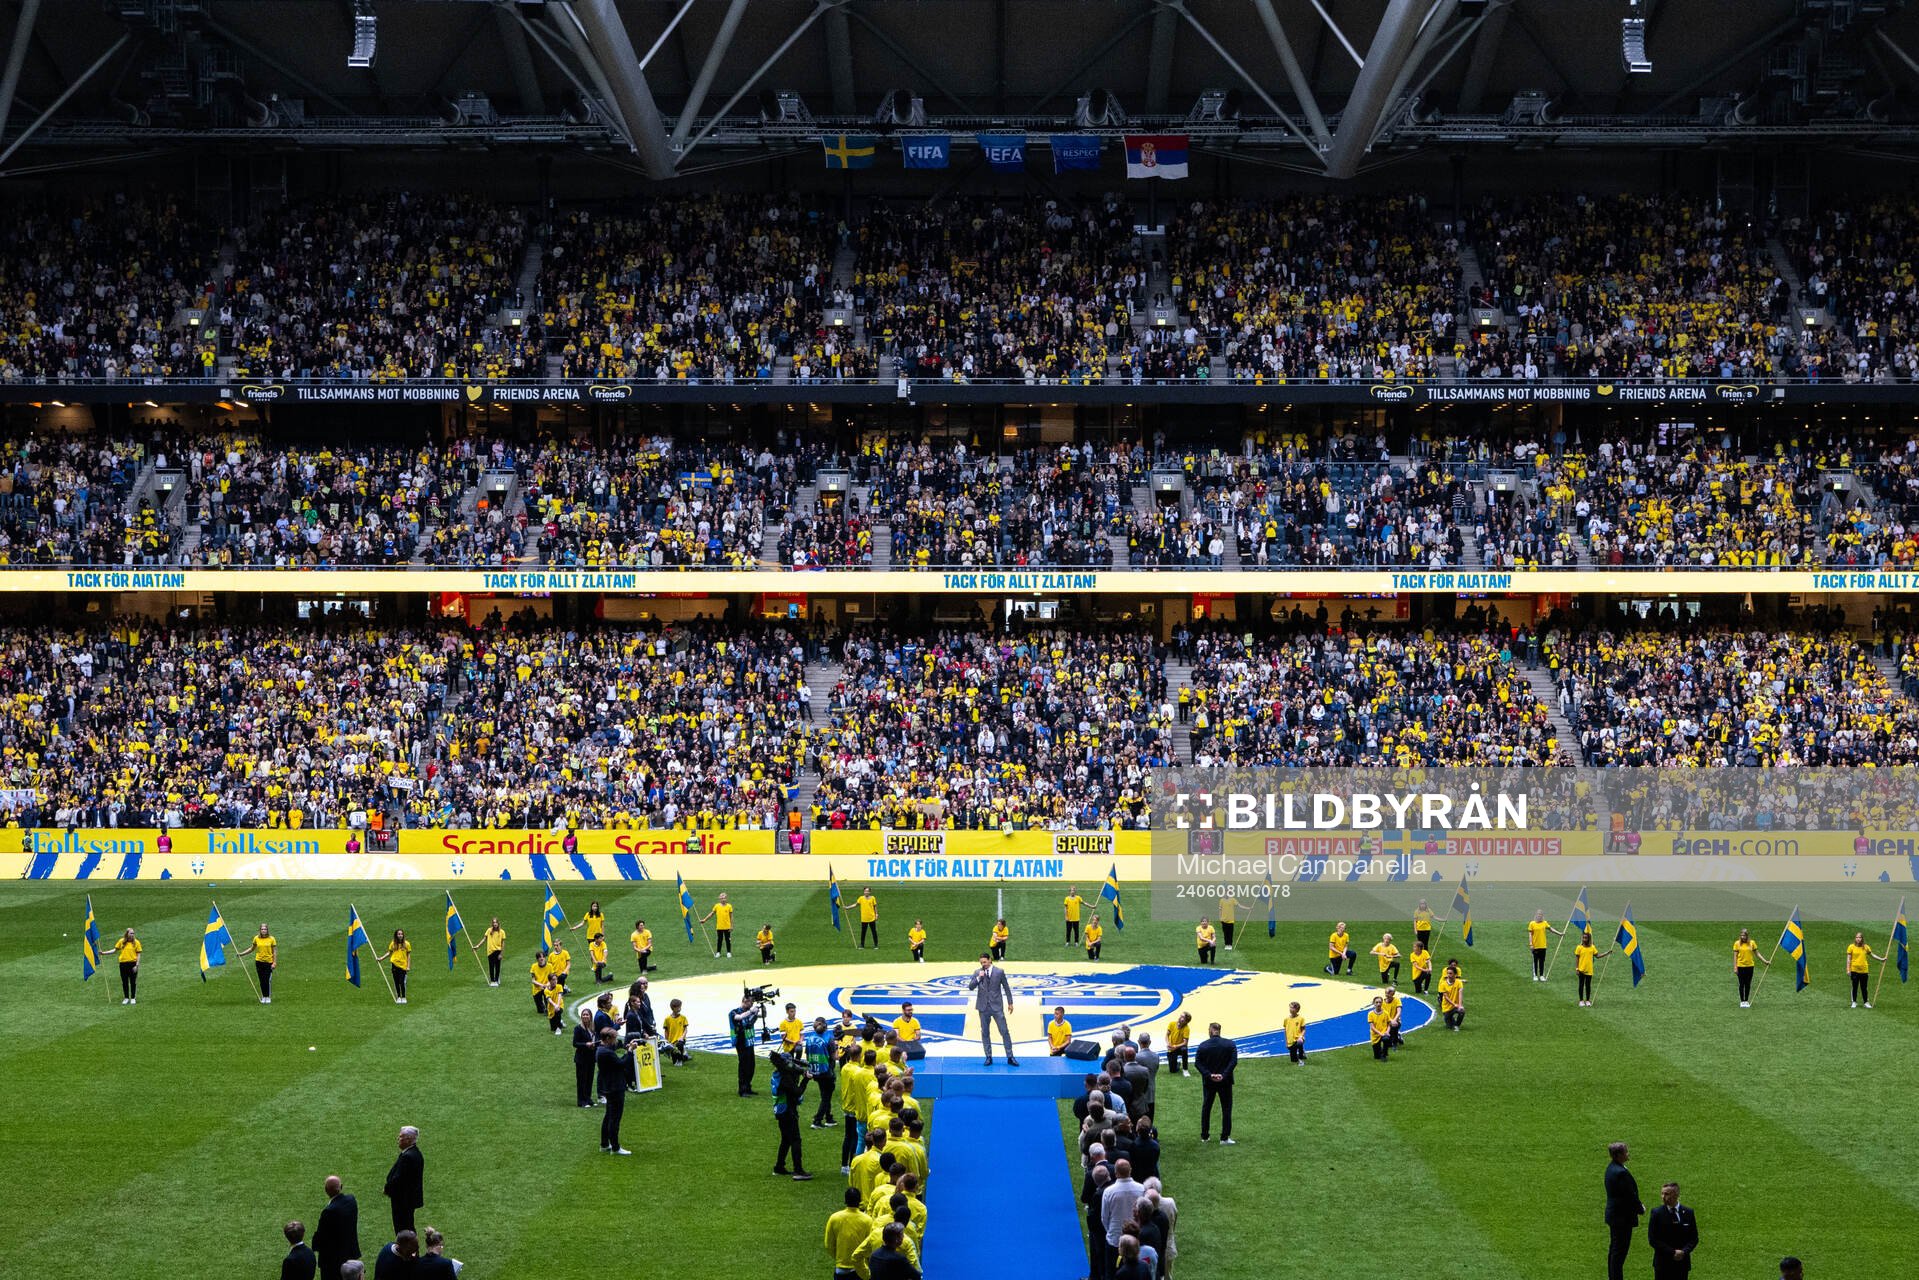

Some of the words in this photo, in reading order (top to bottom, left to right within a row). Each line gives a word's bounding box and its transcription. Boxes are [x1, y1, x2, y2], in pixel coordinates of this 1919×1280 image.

[907, 146, 941, 159] FIFA
[1063, 149, 1099, 158] RESPECT
[247, 388, 278, 398] friends
[298, 388, 374, 399] TILLSAMMANS
[378, 388, 399, 399] MOT
[403, 388, 460, 399] MOBBNING
[493, 388, 540, 399] FRIENDS
[543, 388, 580, 399] ARENA
[595, 388, 626, 398] friends
[1376, 388, 1407, 398] friends
[1427, 388, 1504, 399] TILLSAMMANS
[1508, 388, 1530, 399] MOT
[1534, 388, 1590, 399] MOBBNING
[1619, 388, 1666, 399] FRIENDS
[1669, 388, 1707, 399] ARENA
[67, 573, 101, 587] TACK
[104, 573, 129, 587] FÖR
[483, 574, 517, 588] TACK
[520, 574, 545, 588] FÖR
[548, 574, 578, 588] ALLT
[581, 574, 636, 588] ZLATAN!
[943, 574, 977, 588] TACK
[980, 574, 1005, 588] FÖR
[1008, 574, 1039, 588] ALLT
[1041, 574, 1097, 588] ZLATAN!
[1392, 574, 1426, 588] TACK
[1429, 574, 1454, 588] FÖR
[1812, 574, 1847, 588] TACK
[1849, 574, 1875, 588] FÖR
[1878, 574, 1908, 588] ALLT
[33, 832, 144, 853] Folksam
[208, 832, 319, 853] Folksam
[442, 834, 562, 854] Scandic
[887, 835, 943, 853] SPORT
[1056, 835, 1112, 853] SPORT
[1446, 838, 1561, 855] BAUHAUS
[867, 859, 911, 877] TACK
[915, 859, 948, 877] FÖR
[951, 859, 991, 877] ALLT
[993, 859, 1063, 878] ZLATAN!
